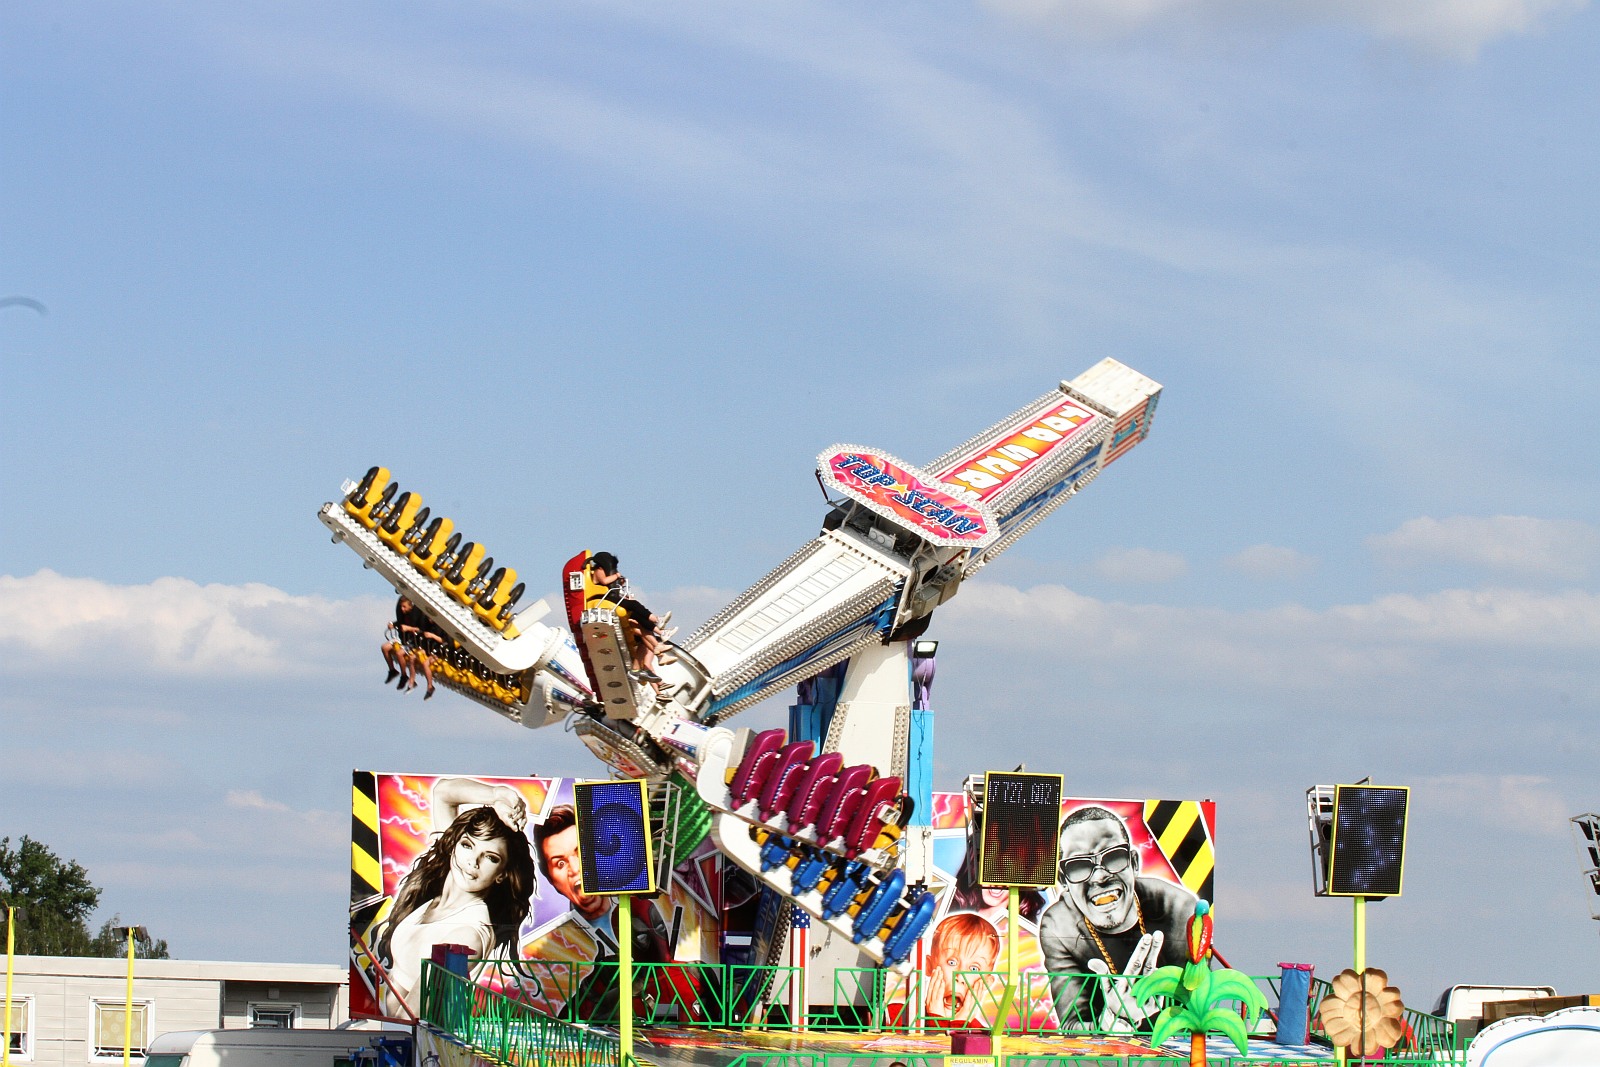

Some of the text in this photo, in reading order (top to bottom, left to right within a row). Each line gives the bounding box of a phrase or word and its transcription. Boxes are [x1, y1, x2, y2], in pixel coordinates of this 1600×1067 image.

[1021, 405, 1094, 442] TOP
[835, 455, 981, 535] TOP SCAN
